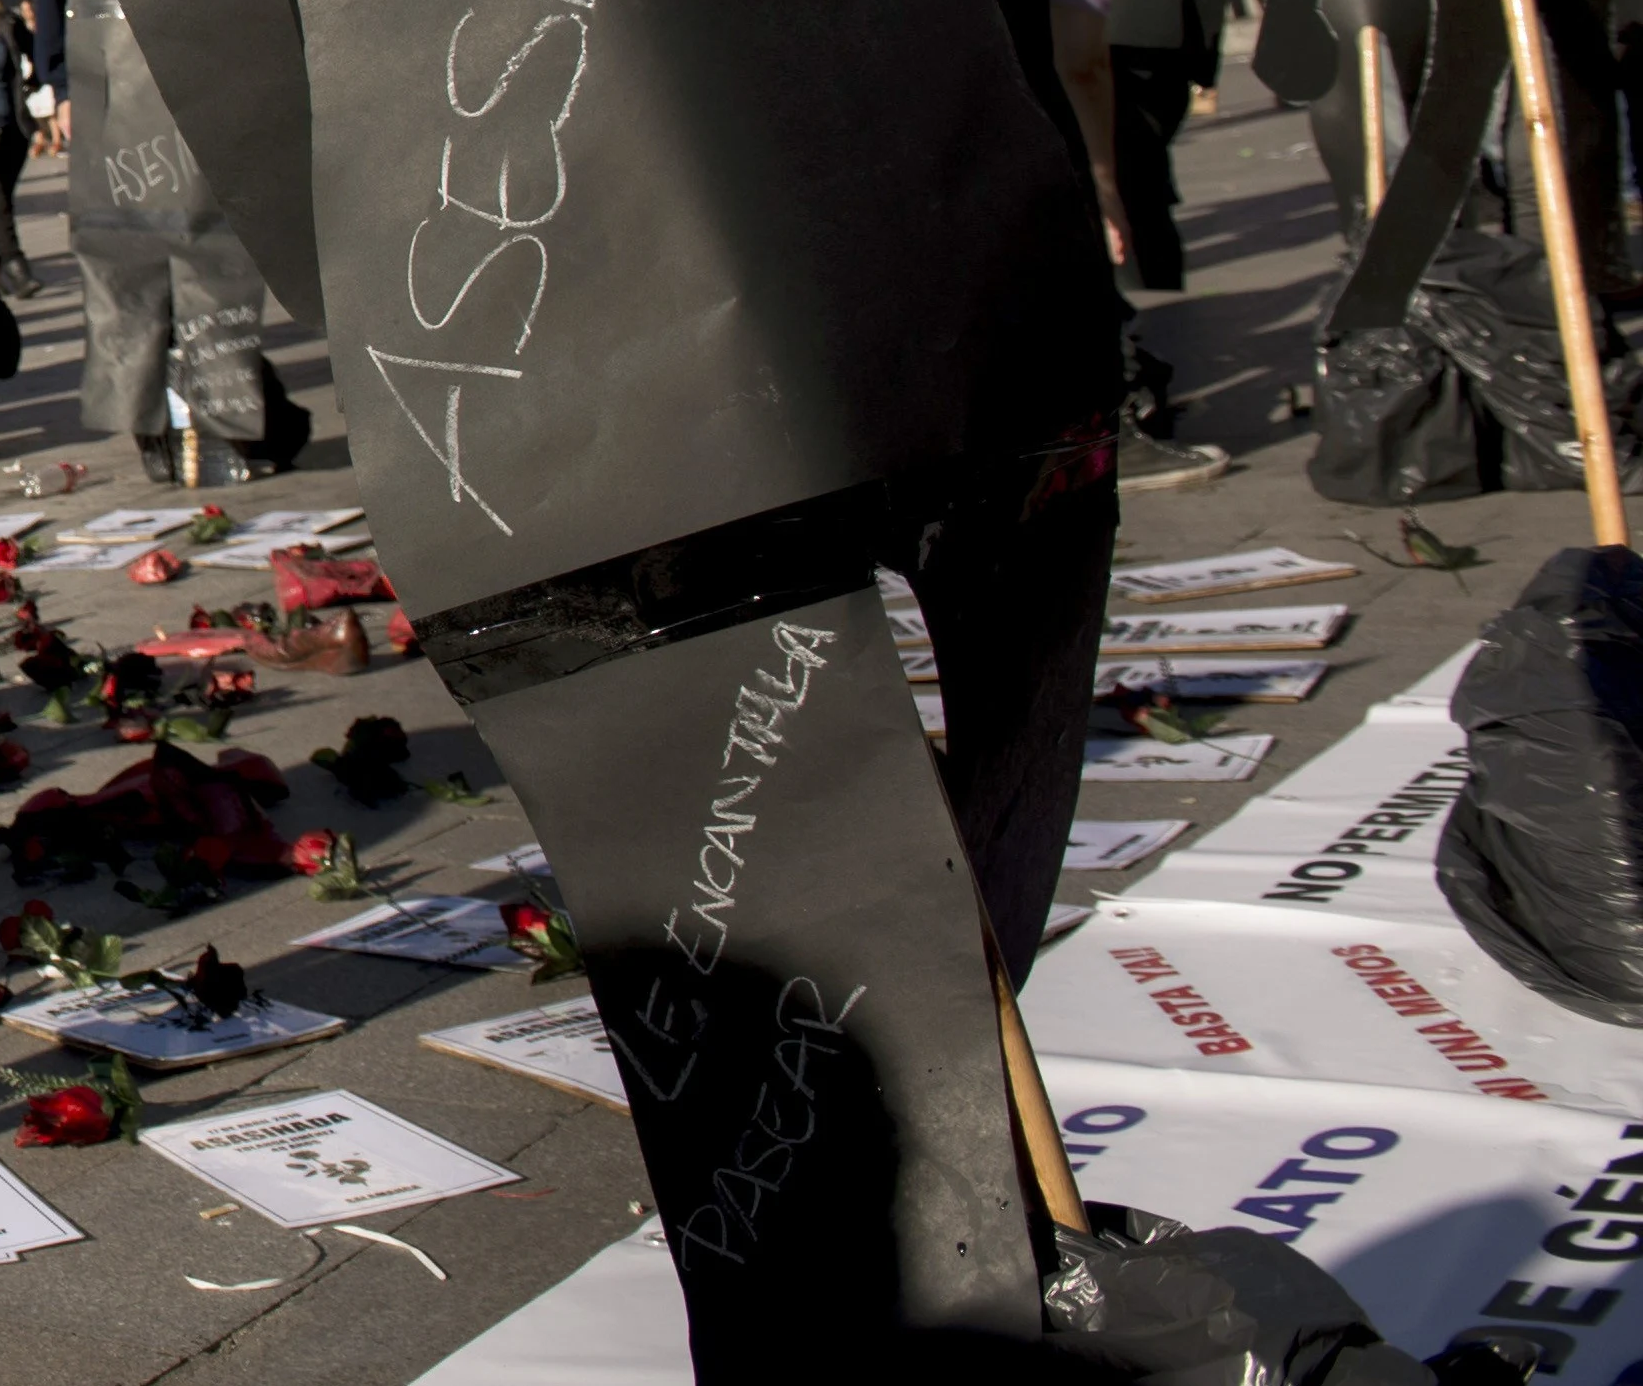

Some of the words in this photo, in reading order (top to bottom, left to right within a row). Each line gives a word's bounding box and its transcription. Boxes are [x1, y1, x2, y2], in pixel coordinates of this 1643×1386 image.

[1261, 860, 1363, 903] NO
[1330, 942, 1446, 1018] MENOS
[1149, 985, 1253, 1056] BASTA
[1414, 1025, 1509, 1072] UNA
[1473, 1076, 1549, 1102] NI
[190, 1112, 352, 1151] ASASINADA
[675, 975, 867, 1271] PASEAR
